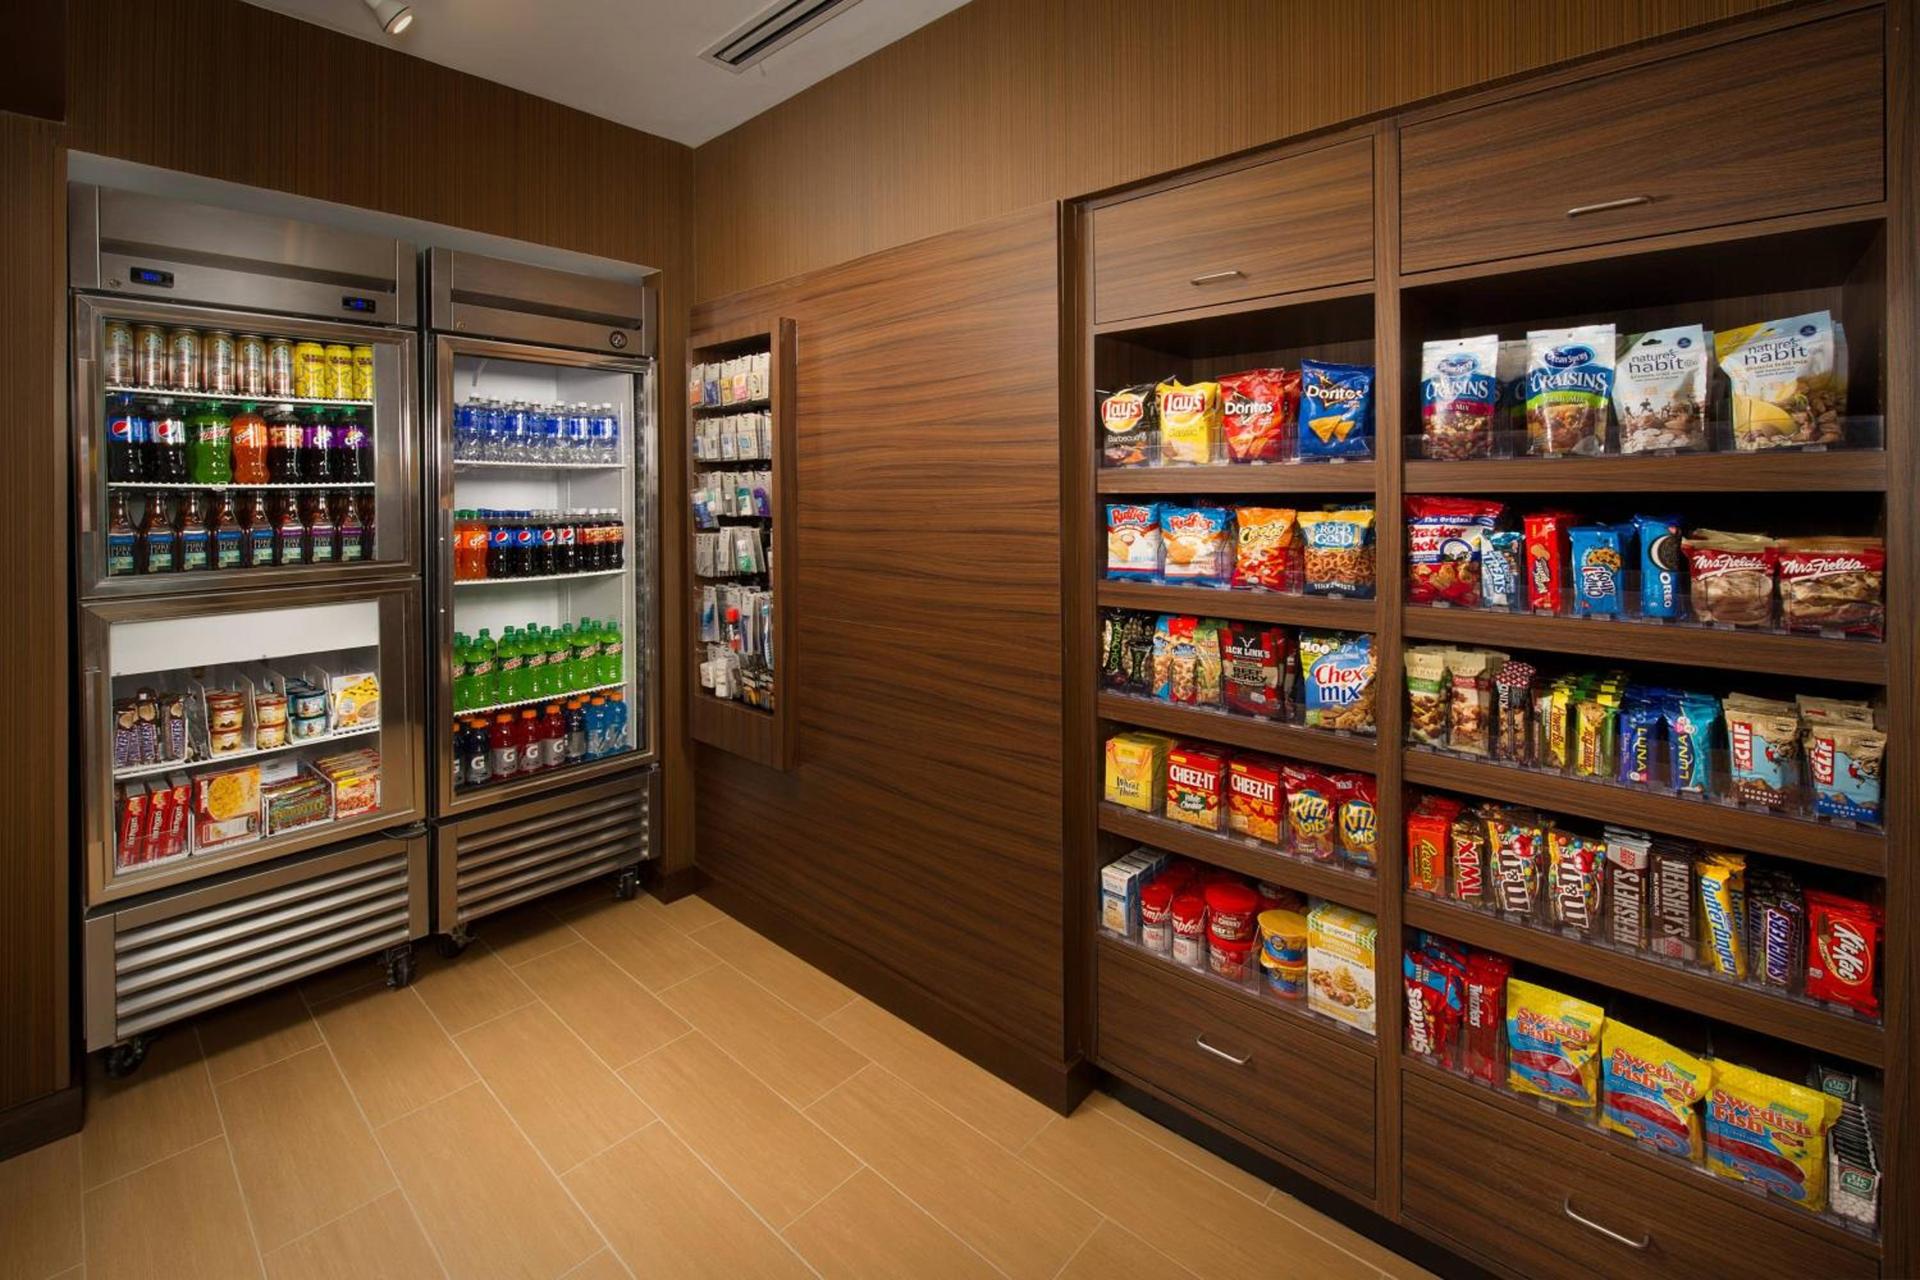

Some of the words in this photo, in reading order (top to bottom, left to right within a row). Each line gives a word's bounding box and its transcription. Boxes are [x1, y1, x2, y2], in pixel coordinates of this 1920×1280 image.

[1631, 349, 1678, 363] nature's
[1744, 346, 1808, 365] habit
[1748, 337, 1799, 354] nature's
[1629, 358, 1685, 373] habit
[1165, 391, 1206, 414] Lay's
[1307, 384, 1364, 400] Doritos
[1105, 400, 1139, 421] Lay's
[1224, 401, 1273, 415] Doritos
[1112, 507, 1149, 524] Ruffles
[1315, 532, 1354, 545] GOLD
[1319, 523, 1352, 533] ROLD
[1482, 551, 1506, 594] TREATS
[1659, 571, 1672, 608] OREO
[1314, 664, 1364, 685] Chex
[1319, 683, 1362, 704] mix
[1498, 685, 1510, 709] KIND
[558, 741, 570, 756] G
[1636, 727, 1648, 772] LUNA
[1734, 723, 1751, 760] CLIF
[472, 758, 487, 774] G
[505, 751, 519, 766] G
[530, 746, 543, 762] G
[1678, 734, 1690, 780] LUNA
[1813, 739, 1833, 775] CLIF
[1169, 764, 1216, 791] CHEEZ-IT
[1230, 773, 1276, 802] CHEEZ-IT
[1290, 795, 1329, 820] RITZ
[1456, 841, 1482, 900] TWIX
[1613, 868, 1640, 946] HERSHEY'S
[1662, 860, 1690, 938] HERSHEY'S
[1701, 875, 1736, 977] Butterfinger
[1768, 909, 1790, 982] SNICKERS
[1516, 1021, 1559, 1044] Fish
[1517, 1007, 1592, 1042] Swedish
[1612, 1047, 1697, 1099] Swedish
[1612, 1061, 1656, 1090] Fish
[1712, 1086, 1813, 1138] Swedish
[1712, 1103, 1765, 1134] Fish
